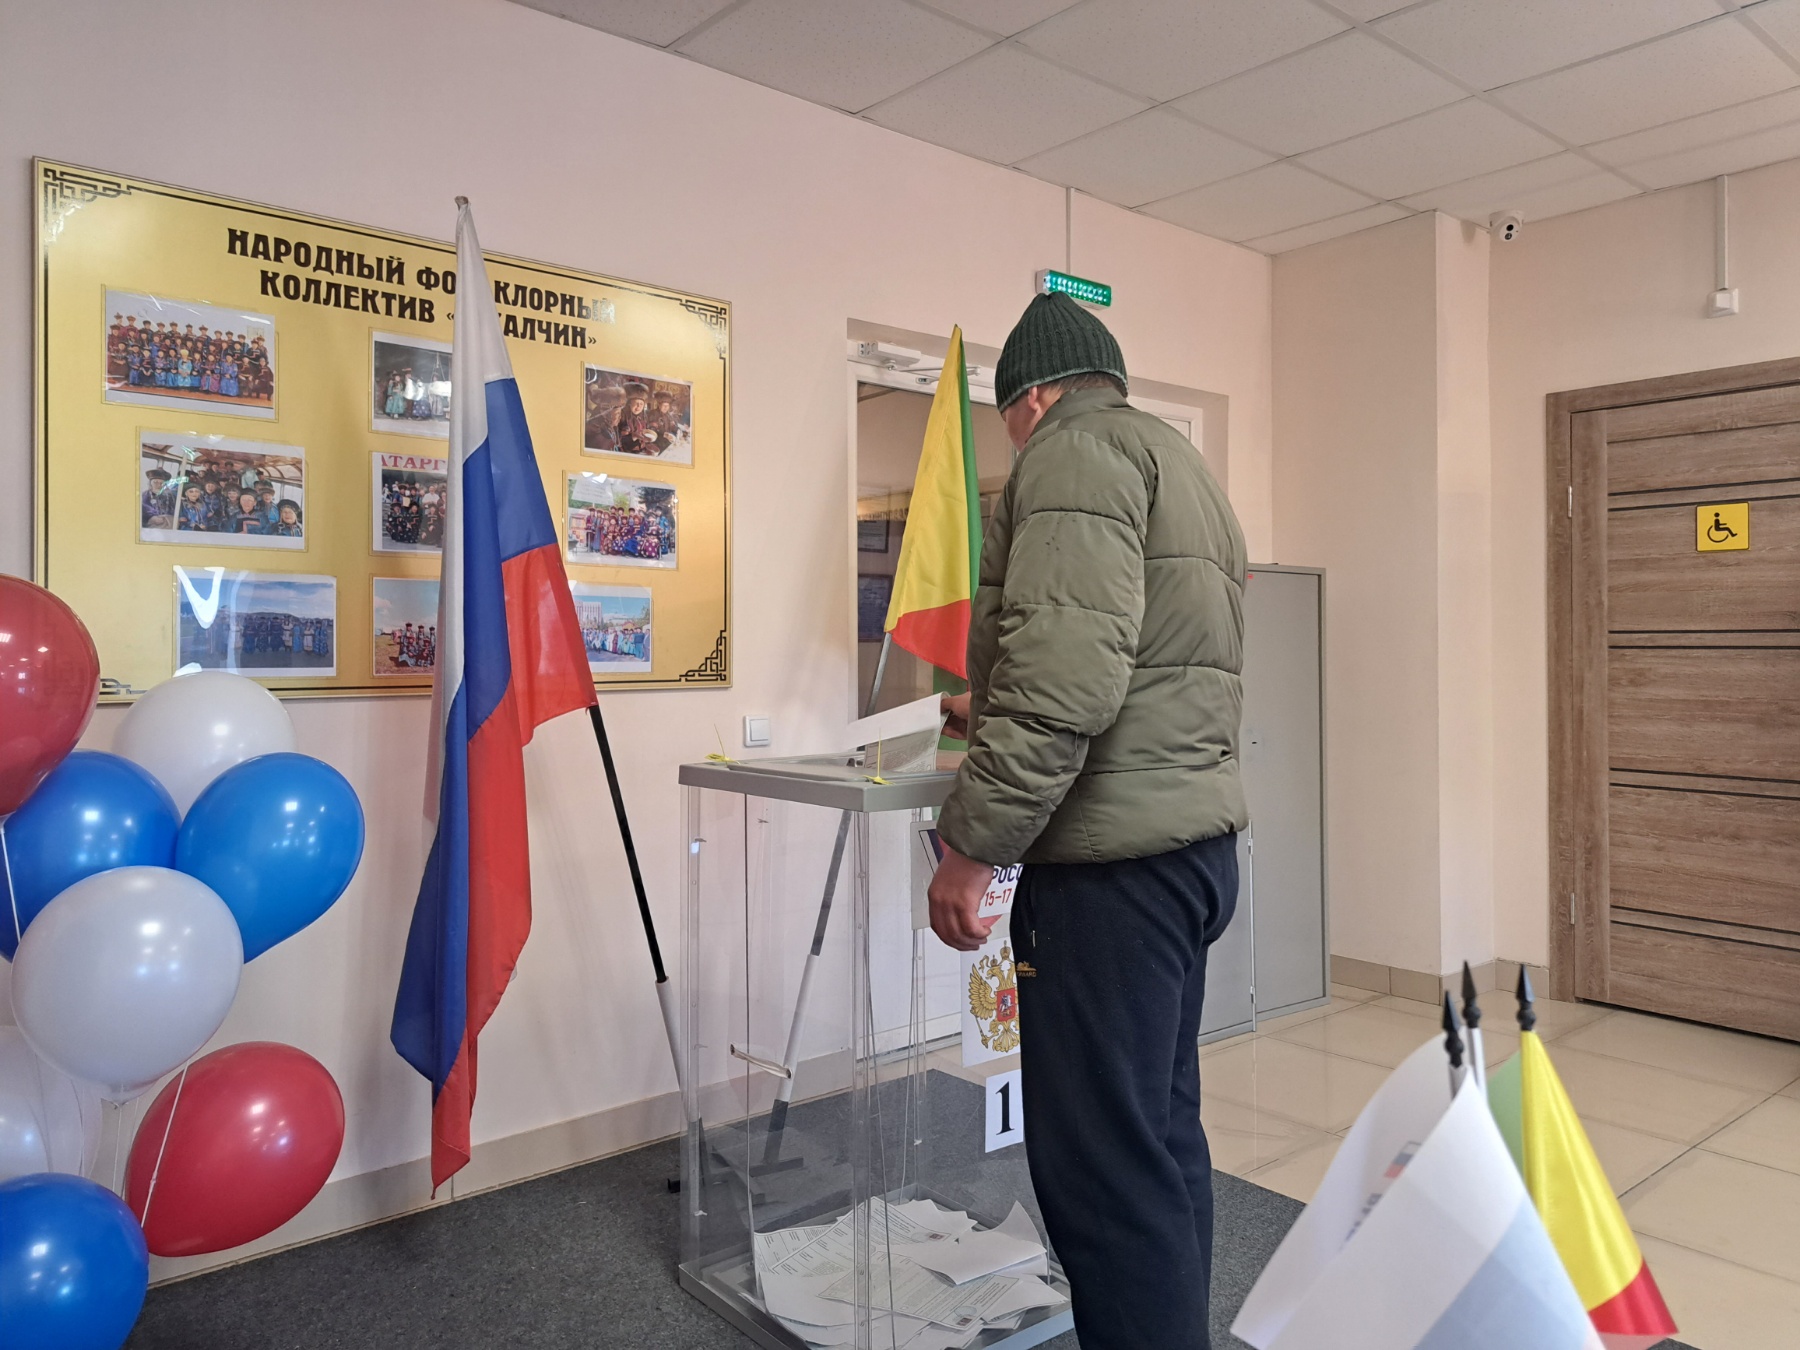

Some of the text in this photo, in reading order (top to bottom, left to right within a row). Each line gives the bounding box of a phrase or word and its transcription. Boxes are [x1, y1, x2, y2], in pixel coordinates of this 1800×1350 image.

[227, 228, 616, 325] НАРОДНЫЙ ФОКЛОРНЫЙ
[260, 270, 597, 349] КОЛЛЕКТИВ «АЛЧИН»
[995, 1081, 1015, 1136] 1
